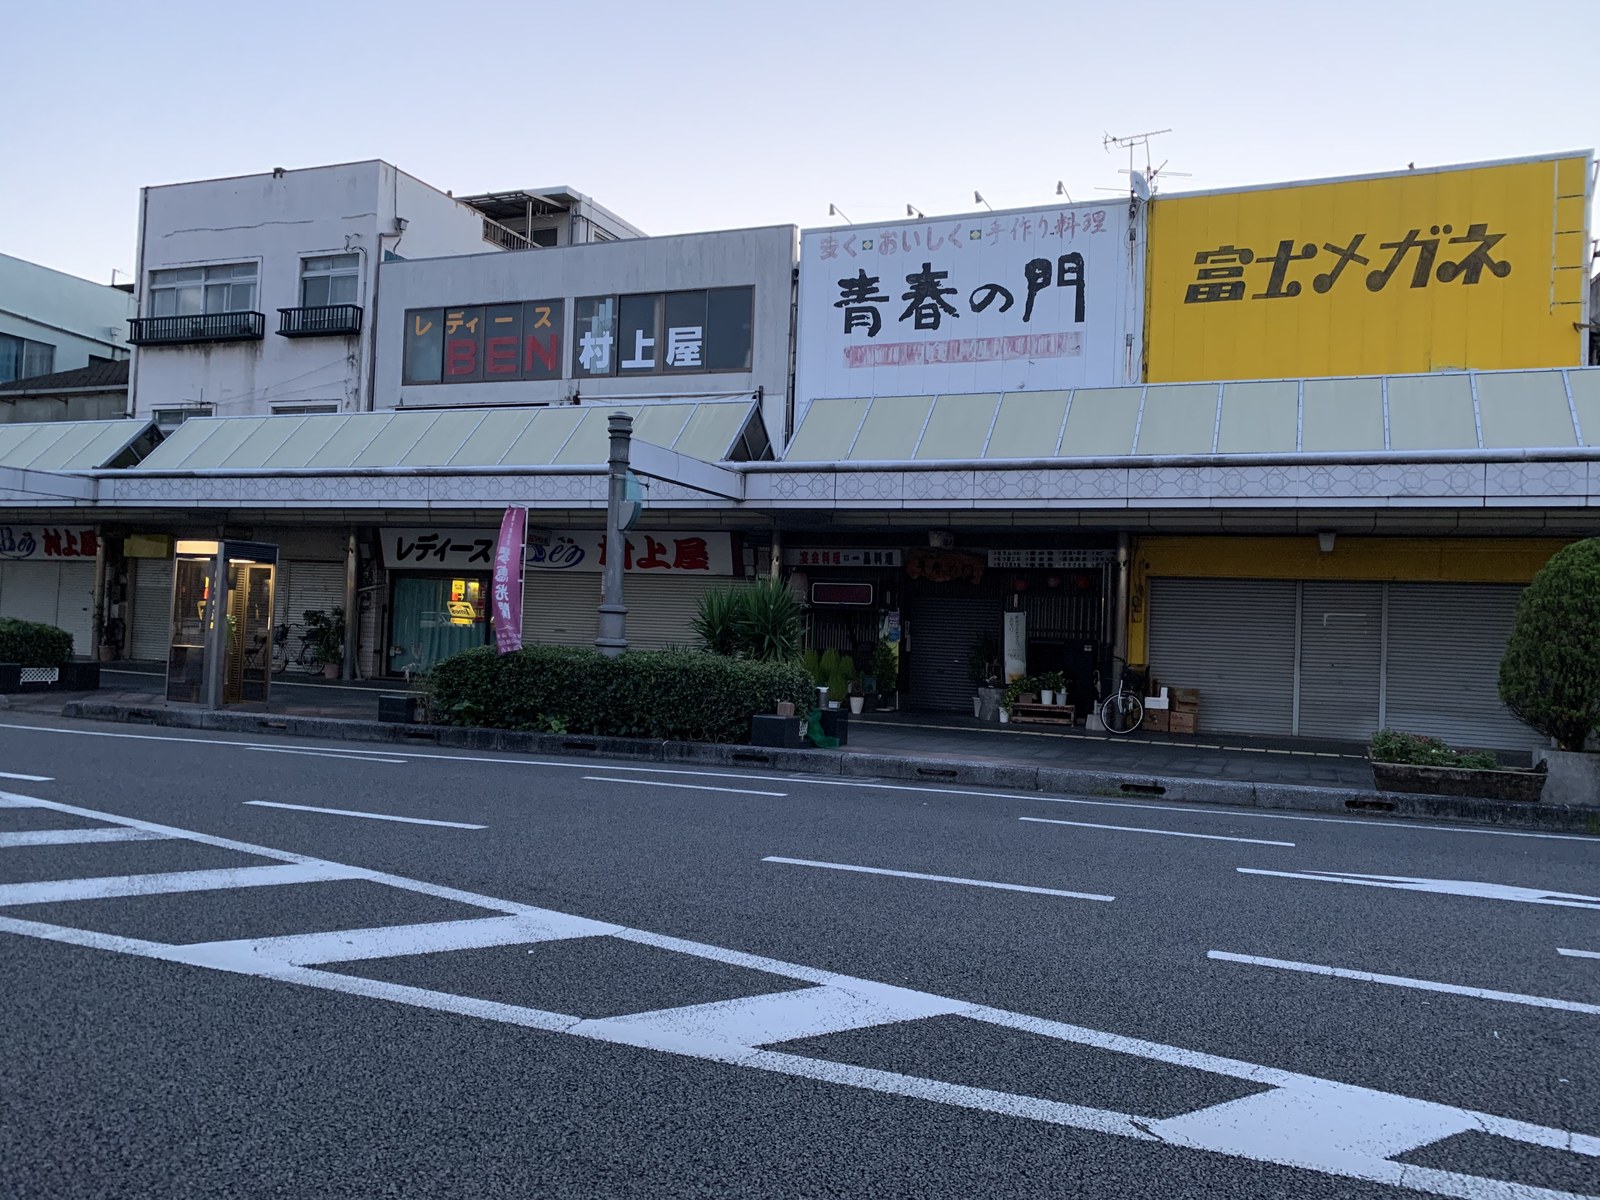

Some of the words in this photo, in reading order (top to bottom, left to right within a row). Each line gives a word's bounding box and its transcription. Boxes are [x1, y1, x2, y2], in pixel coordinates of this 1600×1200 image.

[878, 223, 963, 256] おいしく
[985, 209, 1108, 247] 手作り料理
[1183, 223, 1512, 304] 富士メガネ
[833, 251, 1086, 338] 青春の門
[414, 306, 552, 337] レディース
[447, 334, 558, 376] BEN
[579, 326, 703, 370] 村上屋
[396, 533, 493, 563] レディース
